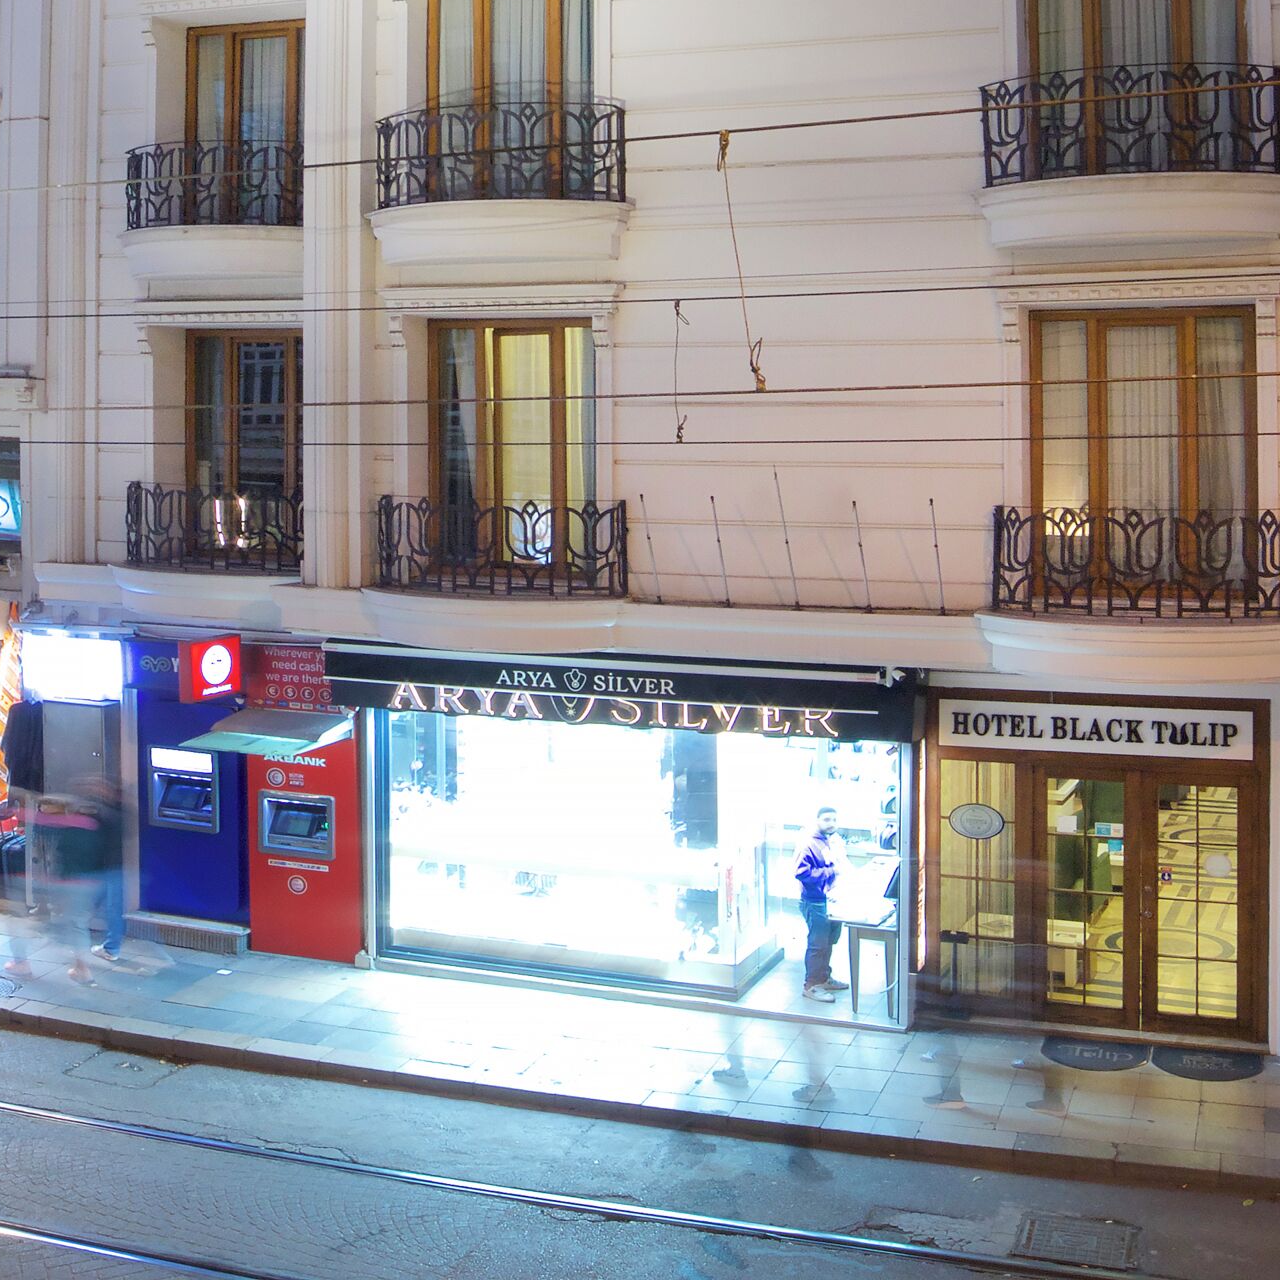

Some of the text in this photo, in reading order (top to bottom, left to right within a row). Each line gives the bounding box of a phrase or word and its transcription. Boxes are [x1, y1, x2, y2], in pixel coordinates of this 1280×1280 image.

[264, 646, 326, 663] Wherever yo
[272, 661, 296, 670] need
[266, 673, 279, 681] we
[282, 673, 300, 682] are
[496, 669, 676, 695] ARYA SİLVER
[387, 681, 543, 719] ARYA
[952, 712, 1238, 747] HOTEL BLACK TULIP
[264, 753, 327, 767] AKBANK
